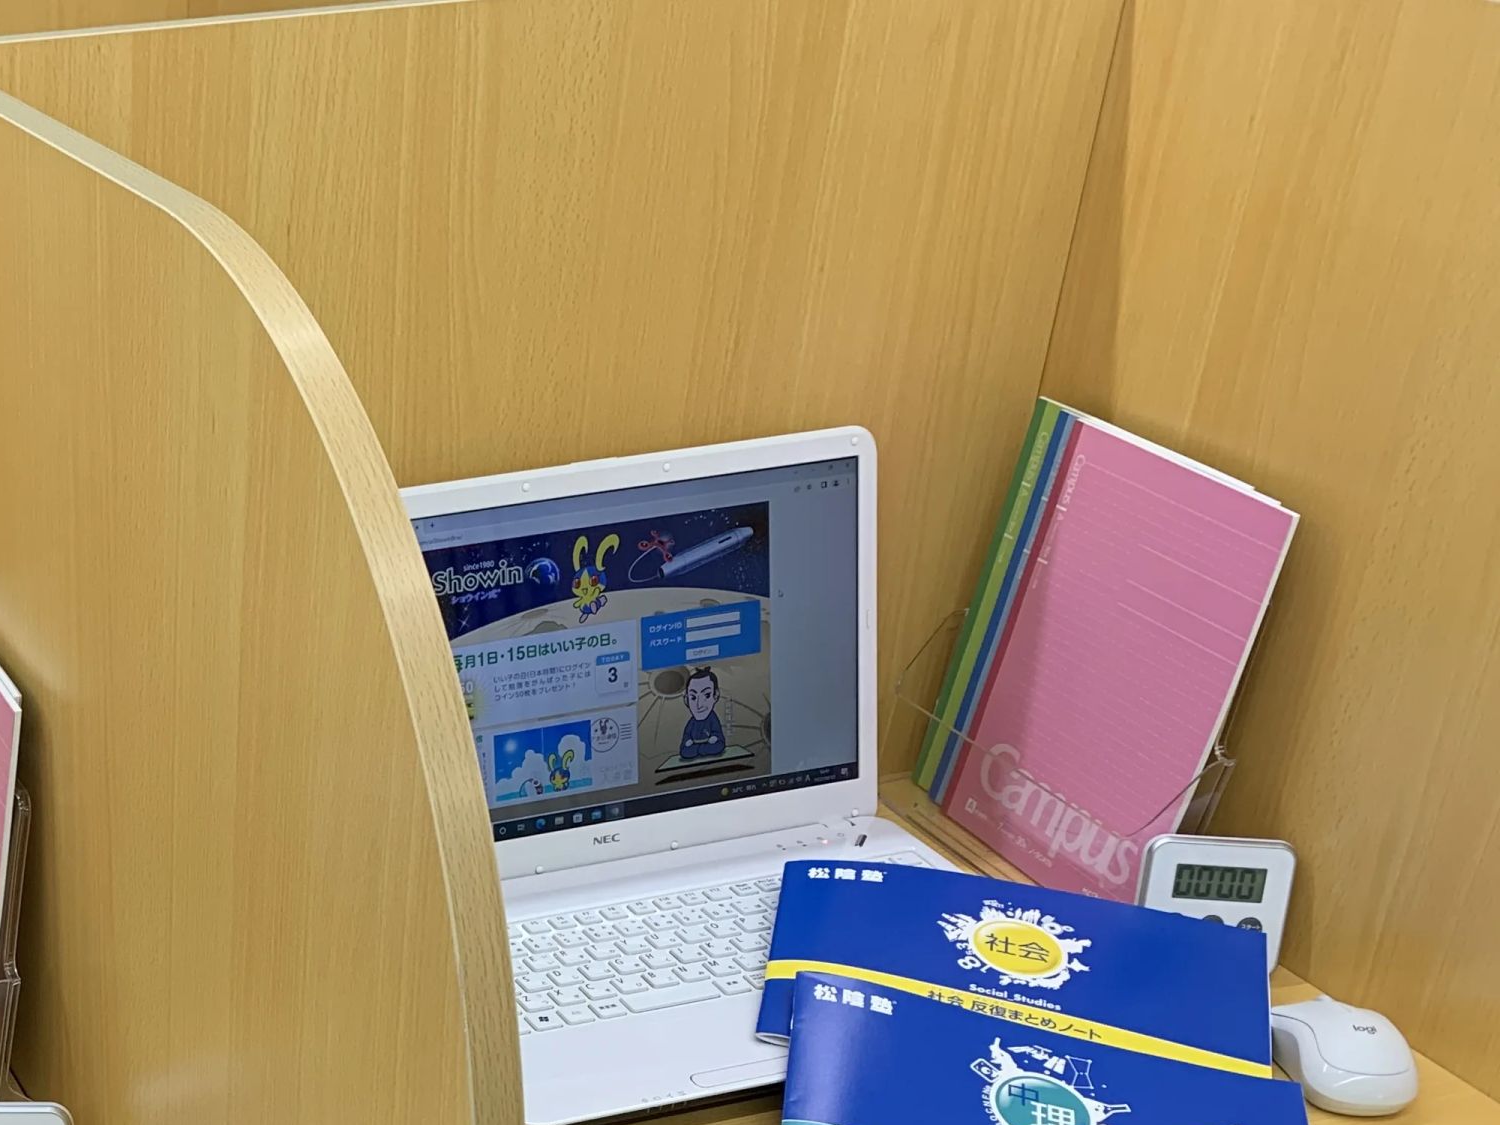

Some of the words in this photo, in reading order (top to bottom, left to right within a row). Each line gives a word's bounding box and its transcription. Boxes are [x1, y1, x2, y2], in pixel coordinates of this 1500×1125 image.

[1063, 454, 1086, 505] Campus
[432, 559, 524, 596] Showin
[649, 621, 682, 633] ログインID
[650, 636, 682, 647] パスワード
[607, 666, 619, 684] 3
[980, 743, 1139, 885] Campus
[593, 833, 621, 845] NEC
[985, 933, 1050, 963] 社会
[969, 983, 1062, 1011] Social_Studies
[927, 989, 964, 1008] 社会
[971, 1000, 1102, 1040] 反復まとめノート
[1353, 1024, 1377, 1035] logi
